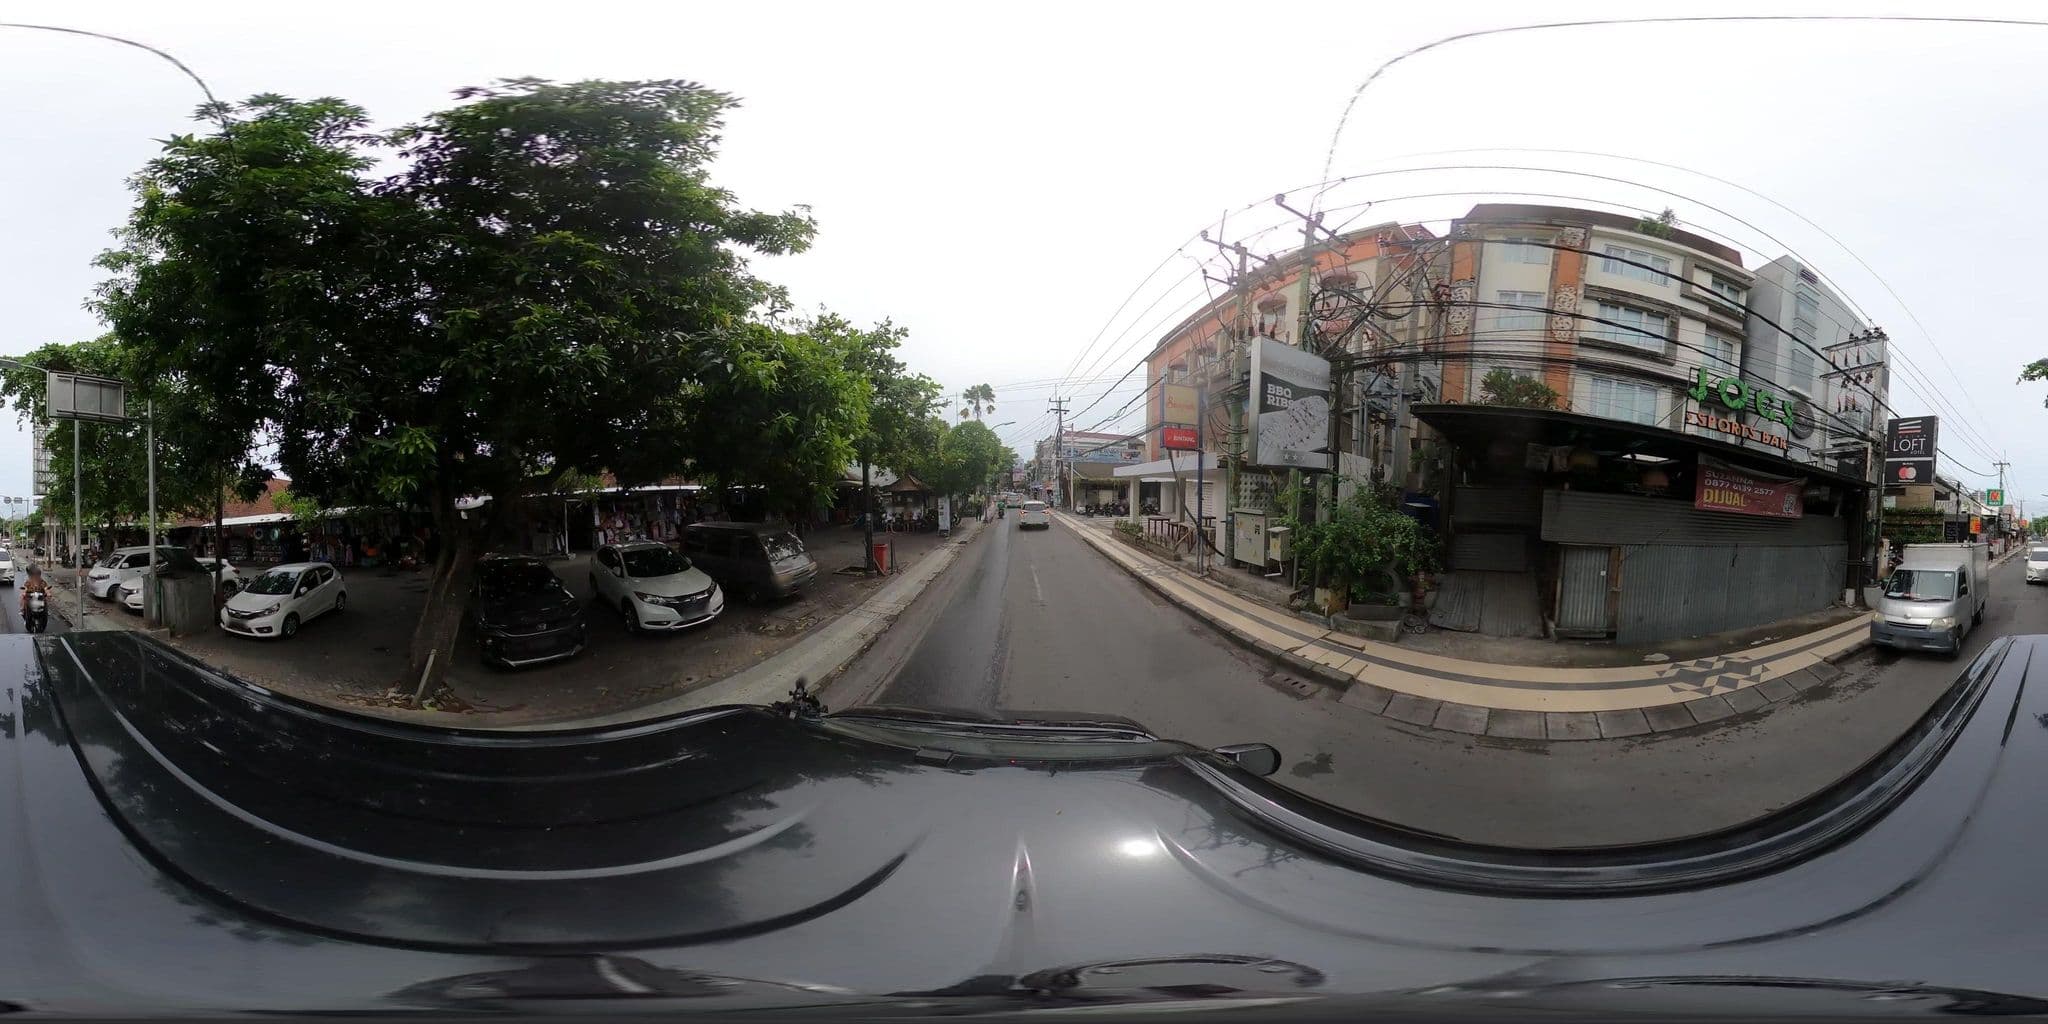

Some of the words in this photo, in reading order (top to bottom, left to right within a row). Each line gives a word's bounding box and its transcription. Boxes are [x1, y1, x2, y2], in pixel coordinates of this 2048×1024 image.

[1267, 383, 1292, 399] BBQ
[1697, 412, 1757, 440] SPORTS
[1761, 431, 1788, 450] BAR
[1893, 438, 1926, 452] LOFT
[1704, 478, 1729, 489] 0877
[1703, 488, 1747, 507] DIJUAL
